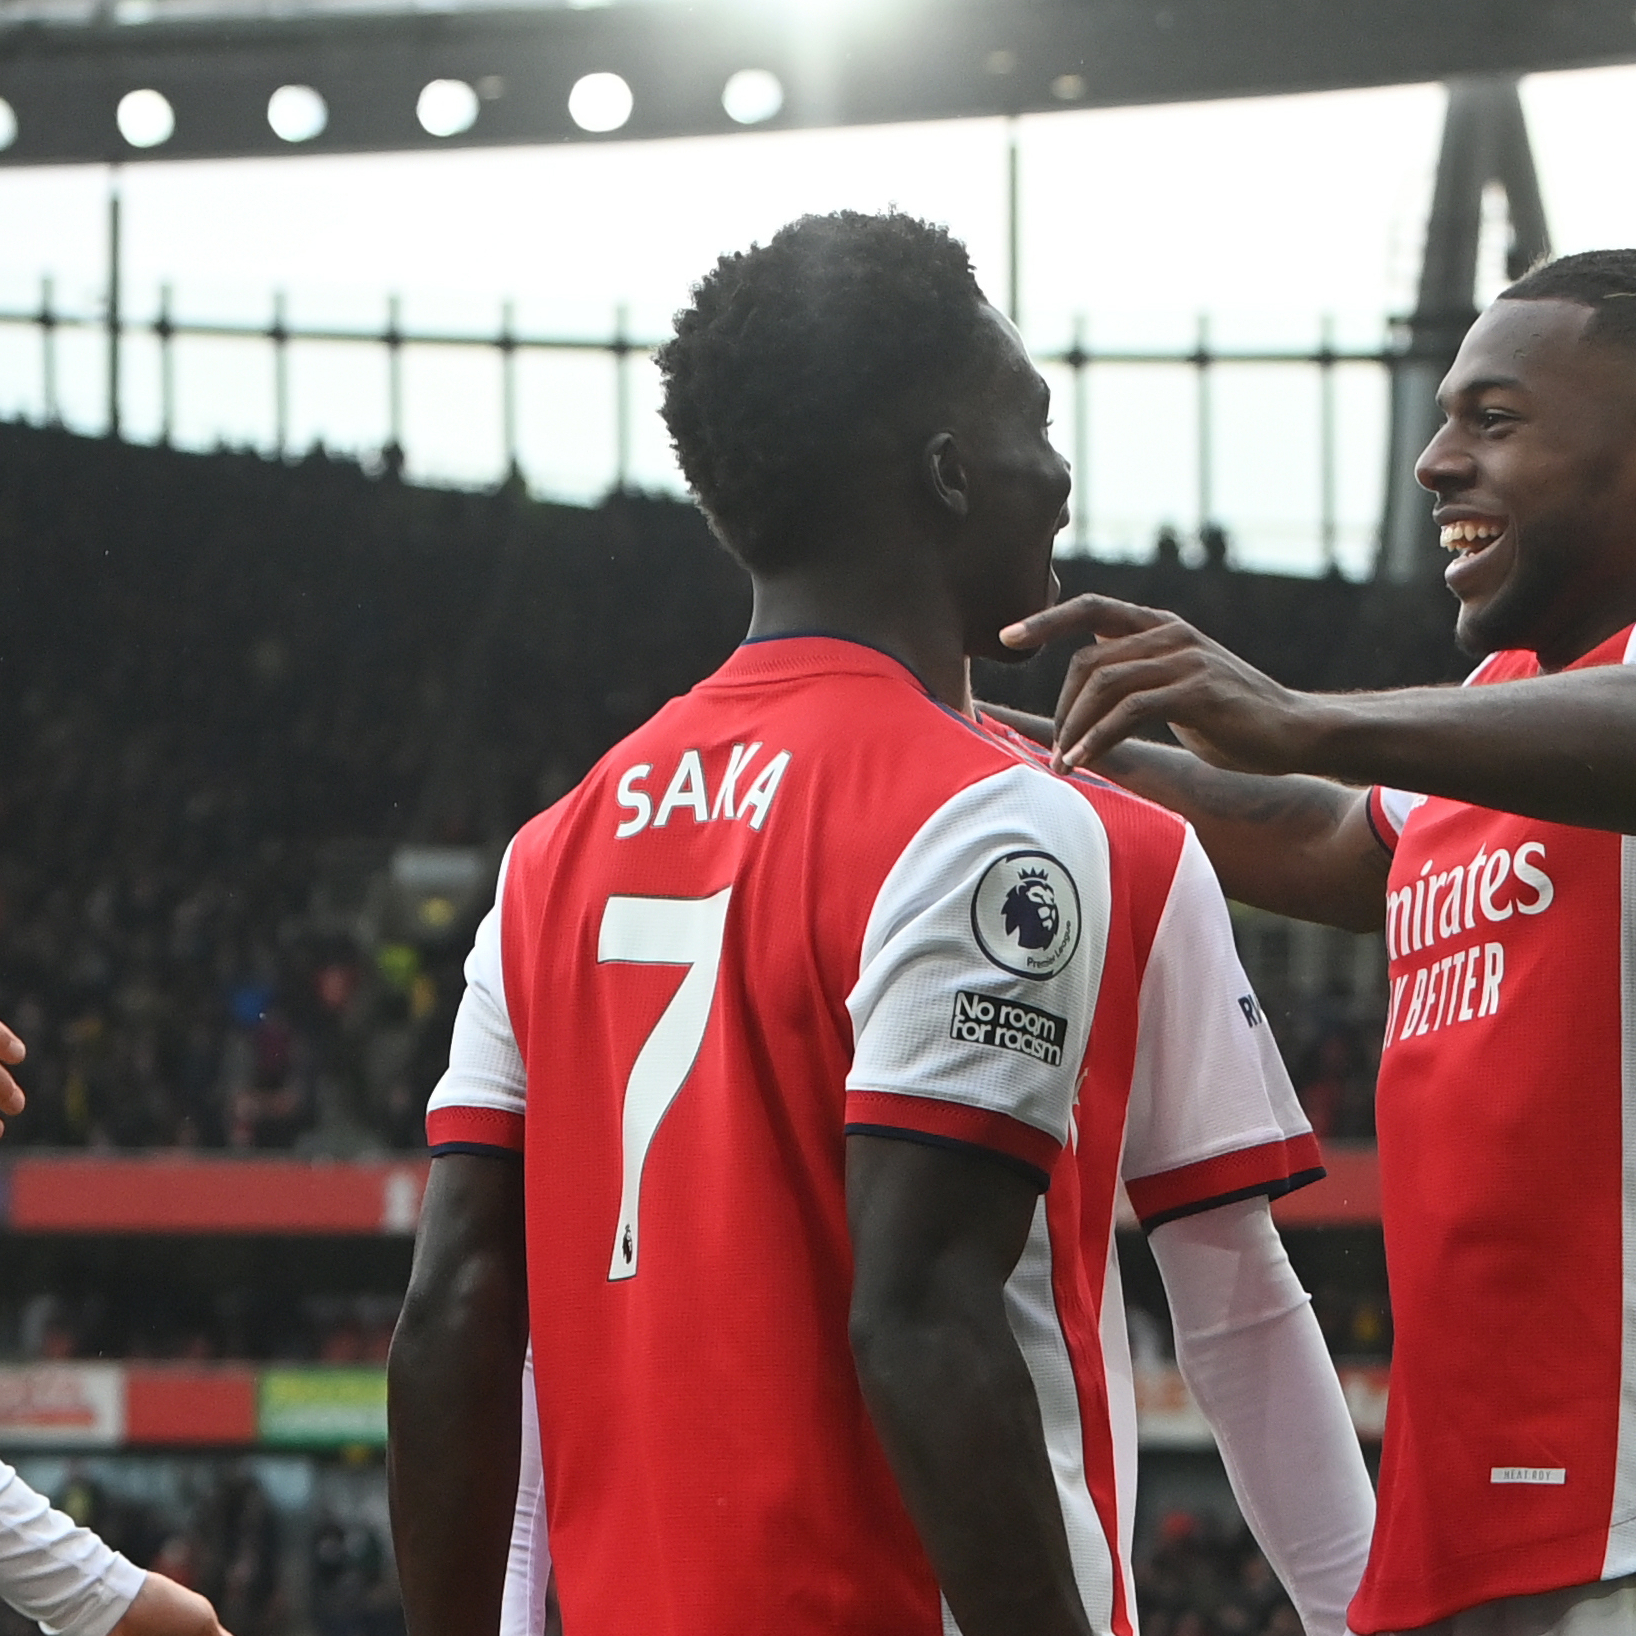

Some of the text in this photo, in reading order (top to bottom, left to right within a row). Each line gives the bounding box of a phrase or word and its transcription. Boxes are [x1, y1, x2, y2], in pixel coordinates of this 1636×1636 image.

[614, 741, 793, 840] SAKA
[1386, 840, 1555, 962] mirates
[950, 1015, 1062, 1066] for racism
[955, 991, 1057, 1042] No room
[1399, 941, 1505, 1041] BETTER
[597, 883, 733, 1282] 7
